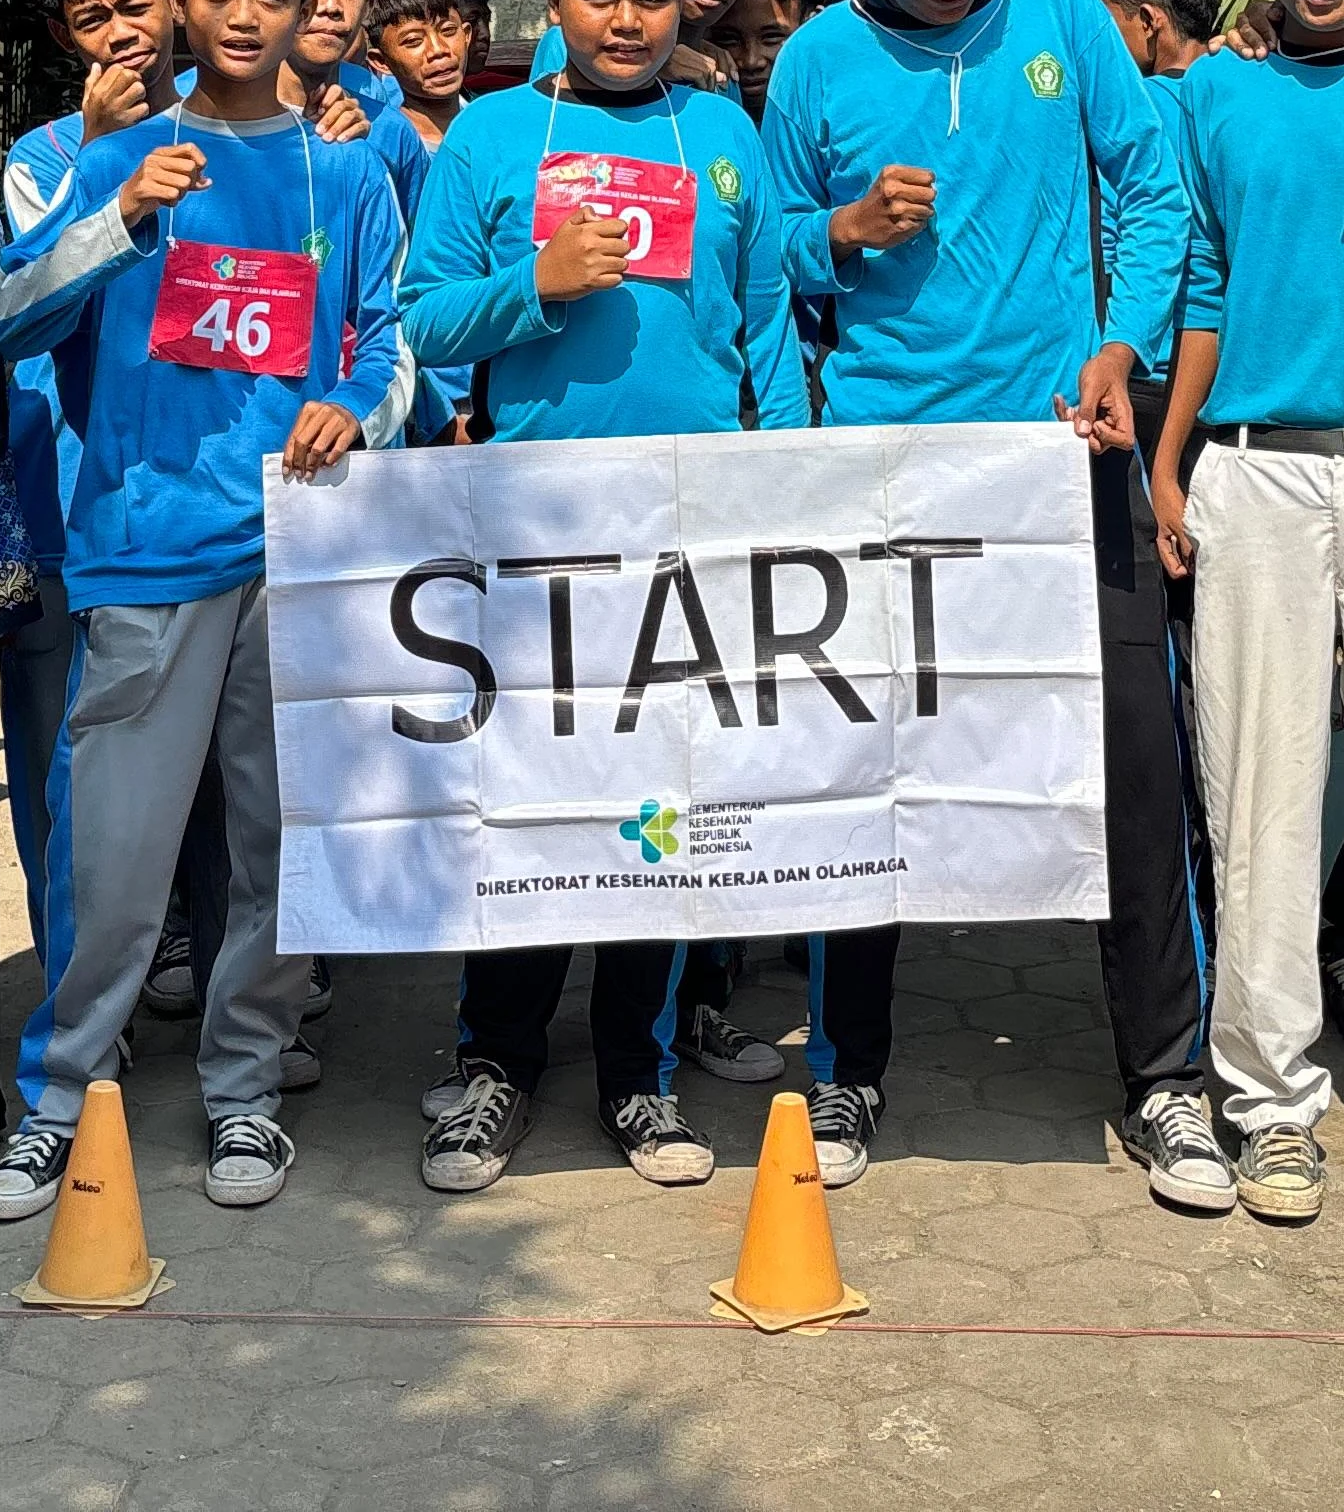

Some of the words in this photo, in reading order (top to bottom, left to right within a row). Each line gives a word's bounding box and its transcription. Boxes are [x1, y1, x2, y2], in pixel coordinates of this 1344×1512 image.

[192, 298, 271, 357] 46
[389, 537, 984, 744] START
[688, 800, 766, 816] KEMENTERIAN
[688, 814, 752, 829] KESEHATAN
[689, 828, 742, 842] REPUBLIK
[689, 841, 752, 856] INDONESIA
[476, 874, 590, 897] DIREKTORAT
[595, 872, 703, 890] KESEHATAN
[708, 869, 769, 888] KERJA
[773, 867, 811, 884] DAN
[815, 856, 909, 881] OLAHRAGA
